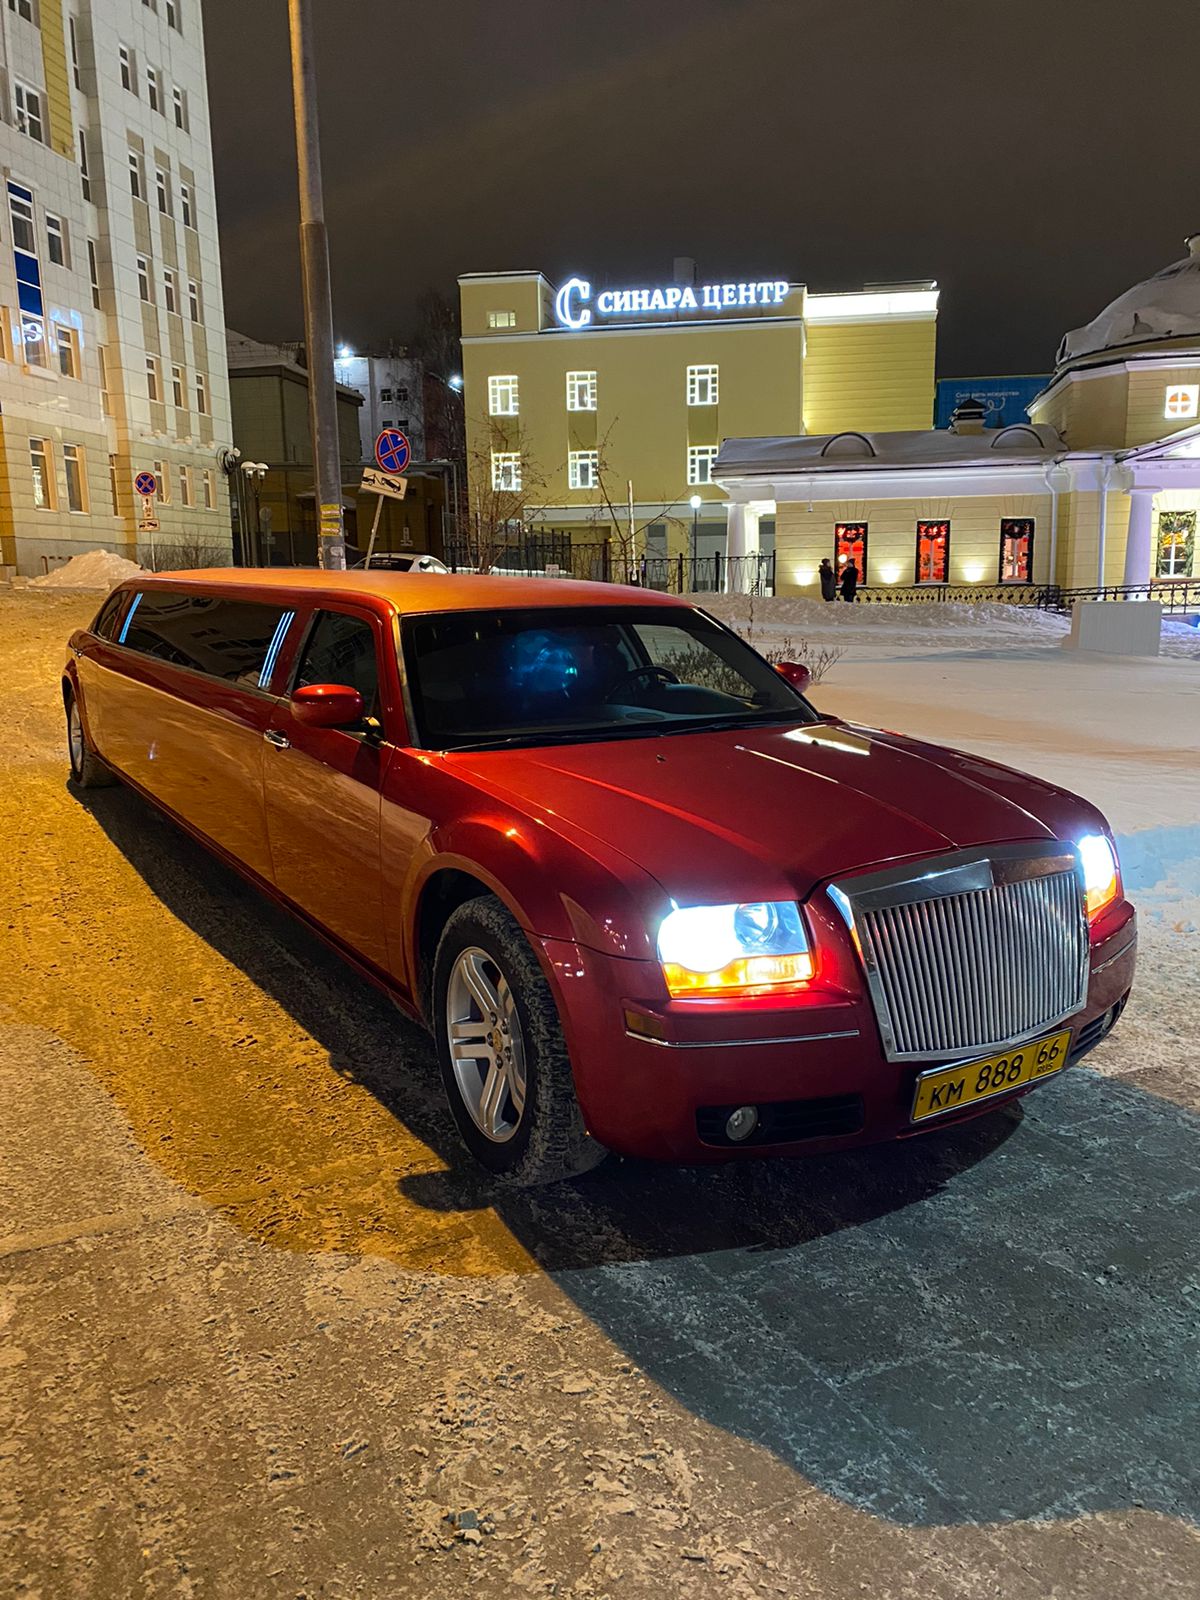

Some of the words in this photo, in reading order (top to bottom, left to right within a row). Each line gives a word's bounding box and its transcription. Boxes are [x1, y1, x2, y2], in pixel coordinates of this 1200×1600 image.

[598, 286, 697, 313] СИНАРА
[702, 281, 789, 309] ЦЕНТР
[1037, 1038, 1060, 1064] 66
[975, 1054, 1024, 1093] 888
